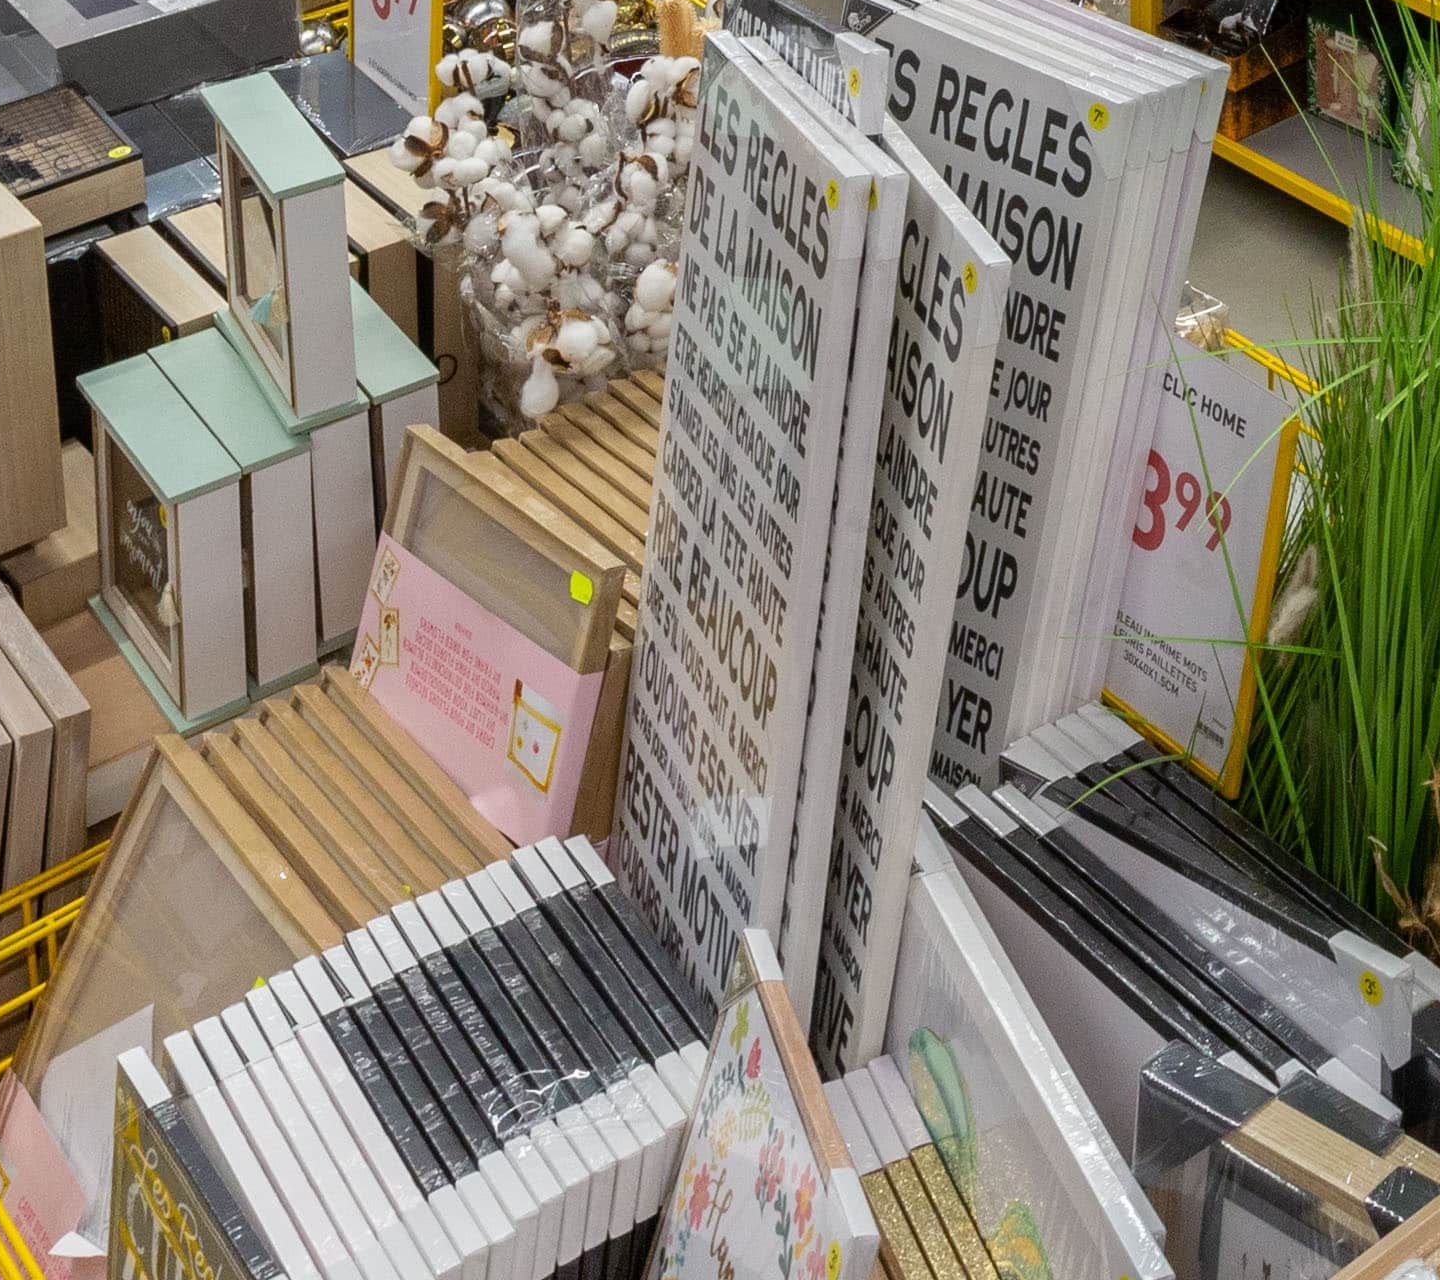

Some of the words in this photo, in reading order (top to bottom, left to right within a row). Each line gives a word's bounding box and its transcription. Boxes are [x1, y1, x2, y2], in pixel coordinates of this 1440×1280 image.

[698, 85, 741, 176] LES
[743, 117, 831, 280] REGLES
[929, 63, 1095, 200] REGLES
[689, 166, 716, 249] DE
[714, 194, 738, 282] LA
[741, 226, 823, 382] MAISON
[675, 322, 697, 379] ETRE
[697, 358, 738, 436] HEUREUX
[736, 404, 776, 489] CHAQUE
[773, 462, 801, 524] JOUR
[681, 253, 698, 315] NE
[699, 273, 727, 348] PAS
[726, 310, 747, 376] SE
[745, 334, 811, 458] PLAINDRE
[1003, 359, 1052, 423] JOUR
[1162, 372, 1198, 409] CLIC
[1200, 394, 1247, 439] HOME
[702, 486, 716, 545] LA
[719, 510, 748, 590] TETE
[746, 552, 787, 648] HAUTE
[755, 502, 793, 582] AUTRES
[1132, 447, 1234, 553] 399
[652, 487, 688, 596] RIRE
[687, 543, 778, 731] BEAUCOUP
[873, 584, 916, 660] AUTRES
[947, 620, 1003, 682] MERCI
[638, 624, 698, 766] TOUJOURS
[622, 738, 680, 892] RESTER
[678, 845, 740, 989] MOTIV
